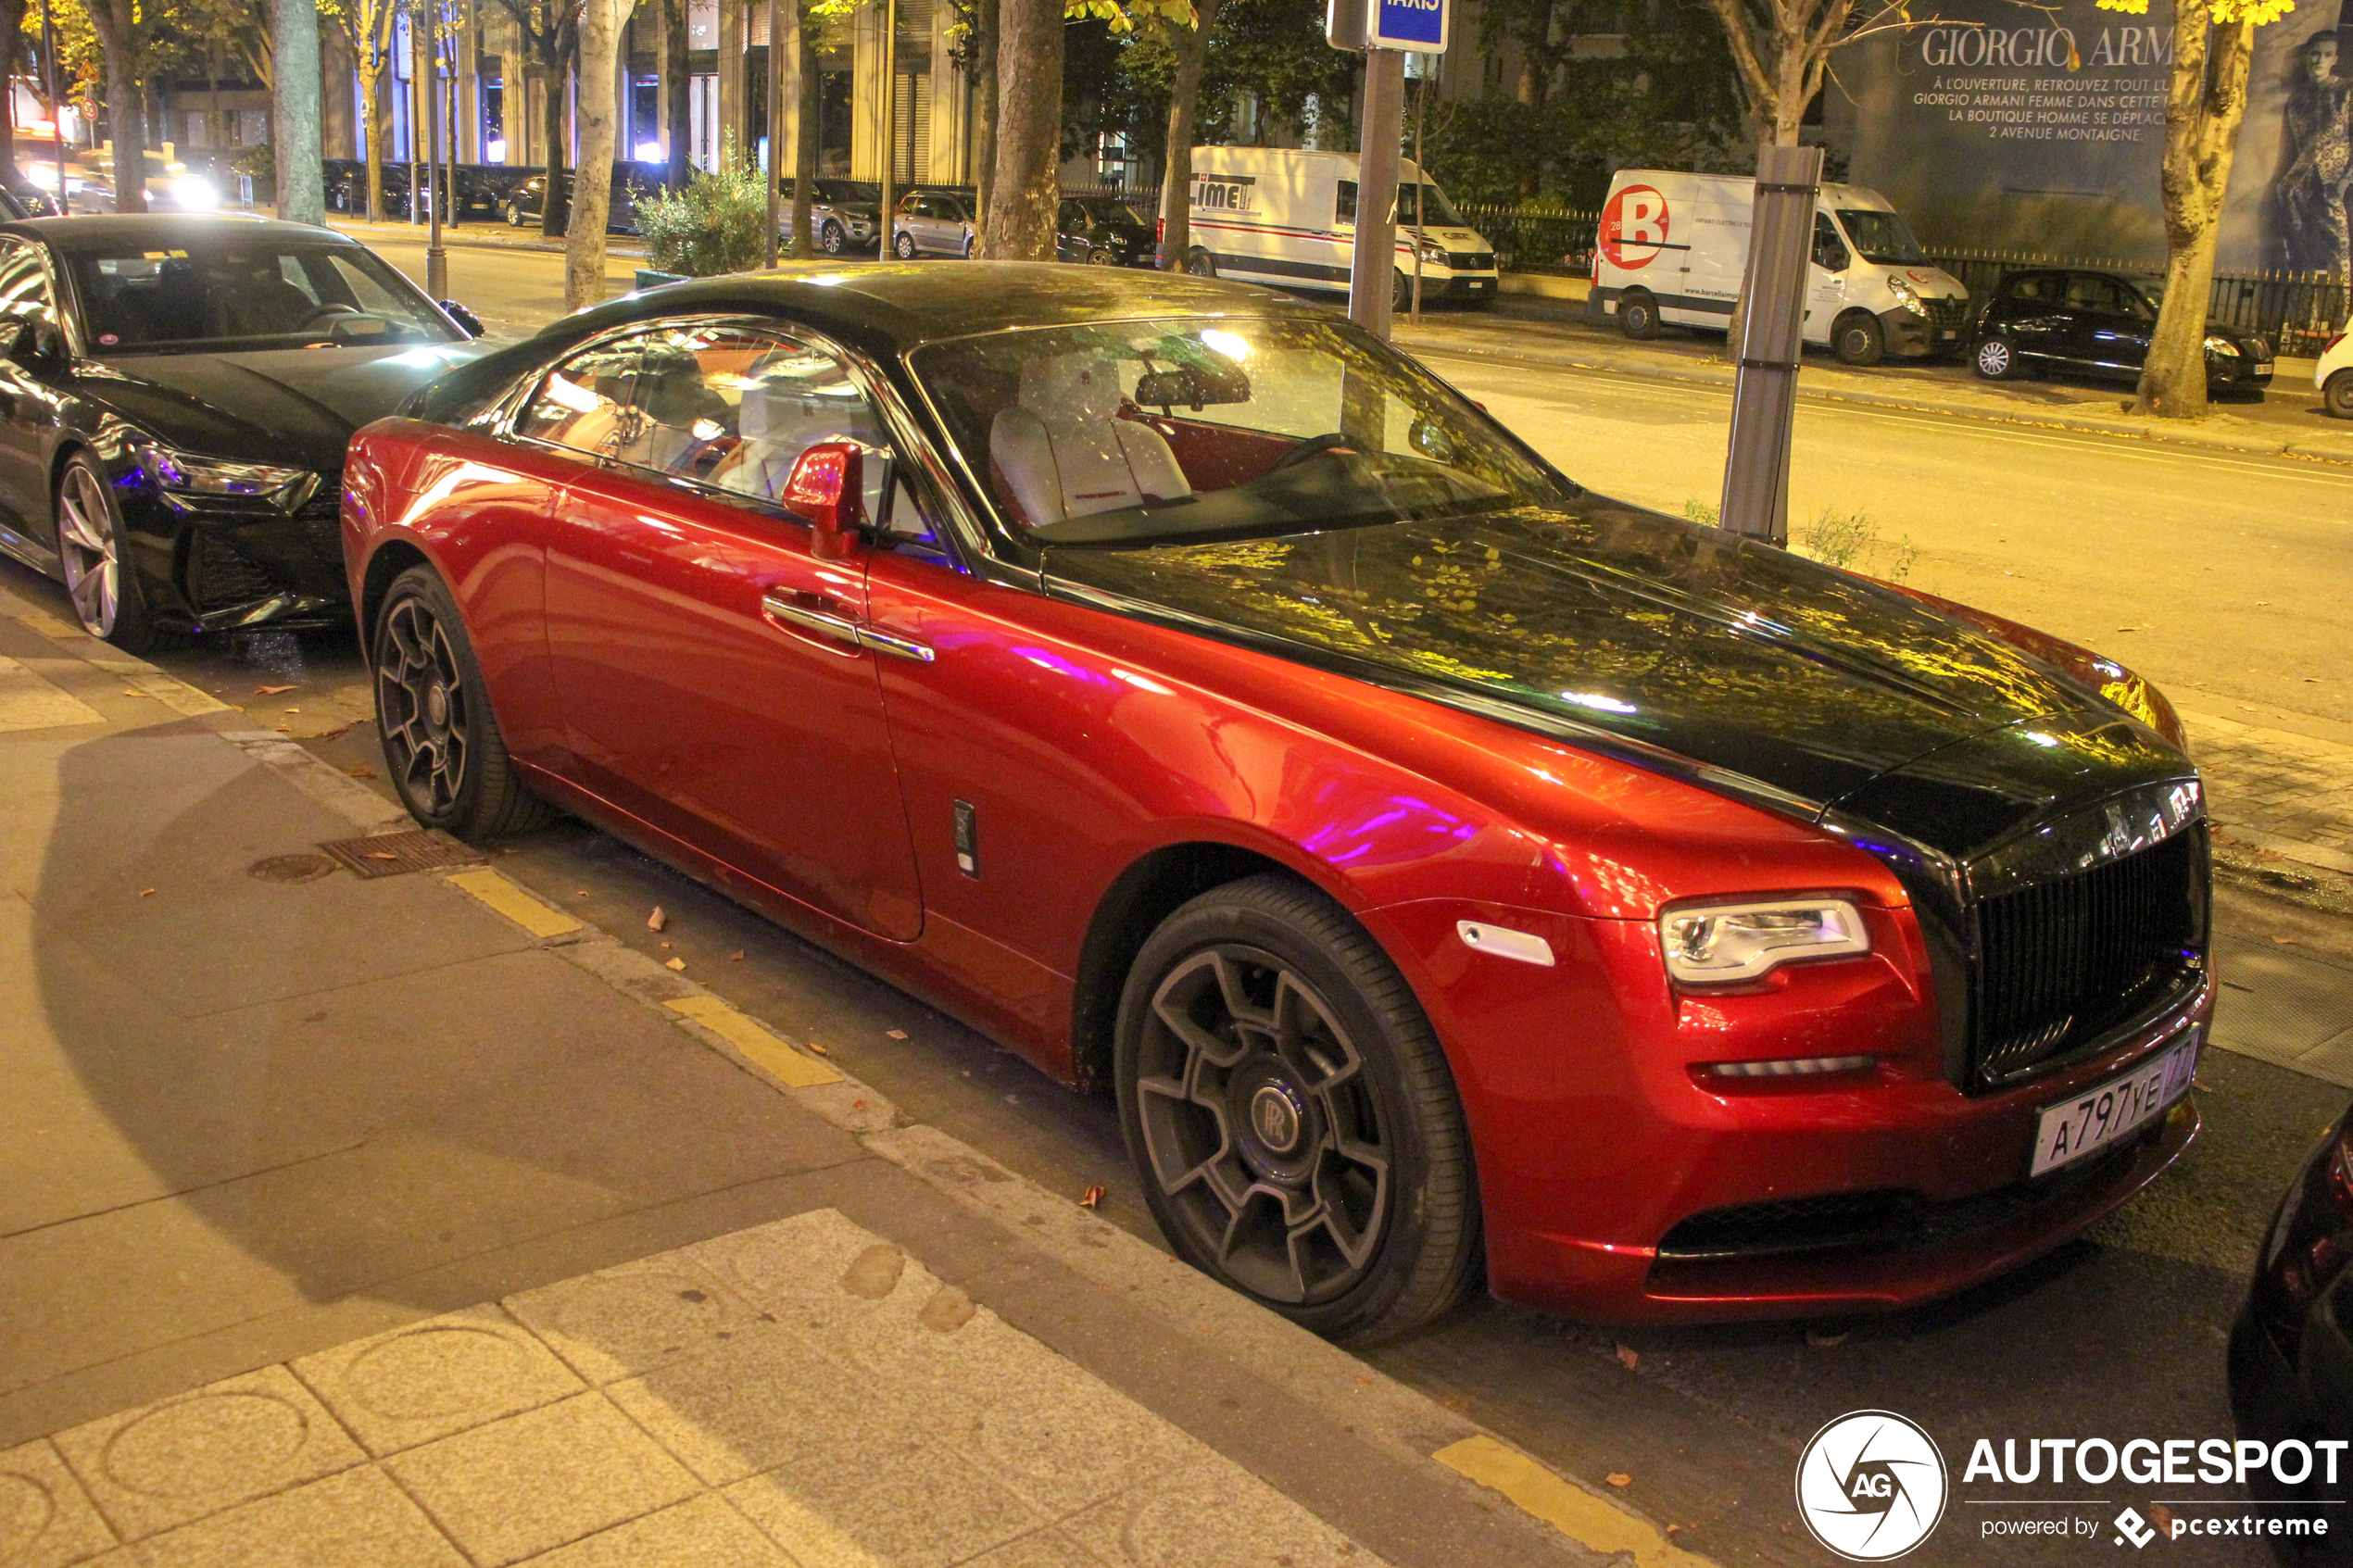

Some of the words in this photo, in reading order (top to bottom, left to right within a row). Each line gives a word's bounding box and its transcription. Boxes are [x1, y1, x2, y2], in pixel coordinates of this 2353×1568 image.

[1922, 27, 2077, 66] GIORGIO
[2087, 26, 2173, 66] ARM
[1933, 76, 1943, 90] À
[1946, 78, 2030, 93] L'OUVERTURE,
[2034, 79, 2108, 92] RETROUVEZ
[2115, 79, 2148, 92] TOUT
[1914, 93, 1969, 106] GIORGIO
[1973, 94, 2024, 107] ARMANI
[2028, 95, 2073, 107] FEMME
[2078, 95, 2115, 108] DANS
[2120, 95, 2158, 108] CETTE
[1949, 110, 1963, 121] LA
[1968, 110, 2032, 123] BOUTIQUE
[2037, 111, 2089, 124] HOMME
[2094, 112, 2108, 125] SE
[1989, 126, 1996, 138] 2
[2001, 127, 2052, 140] AVENUE
[2057, 128, 2144, 141] MONTAIGNE.
[1610, 220, 1621, 232] 28
[1621, 190, 1664, 263] B
[1684, 288, 1741, 300] www.barcellaimpi
